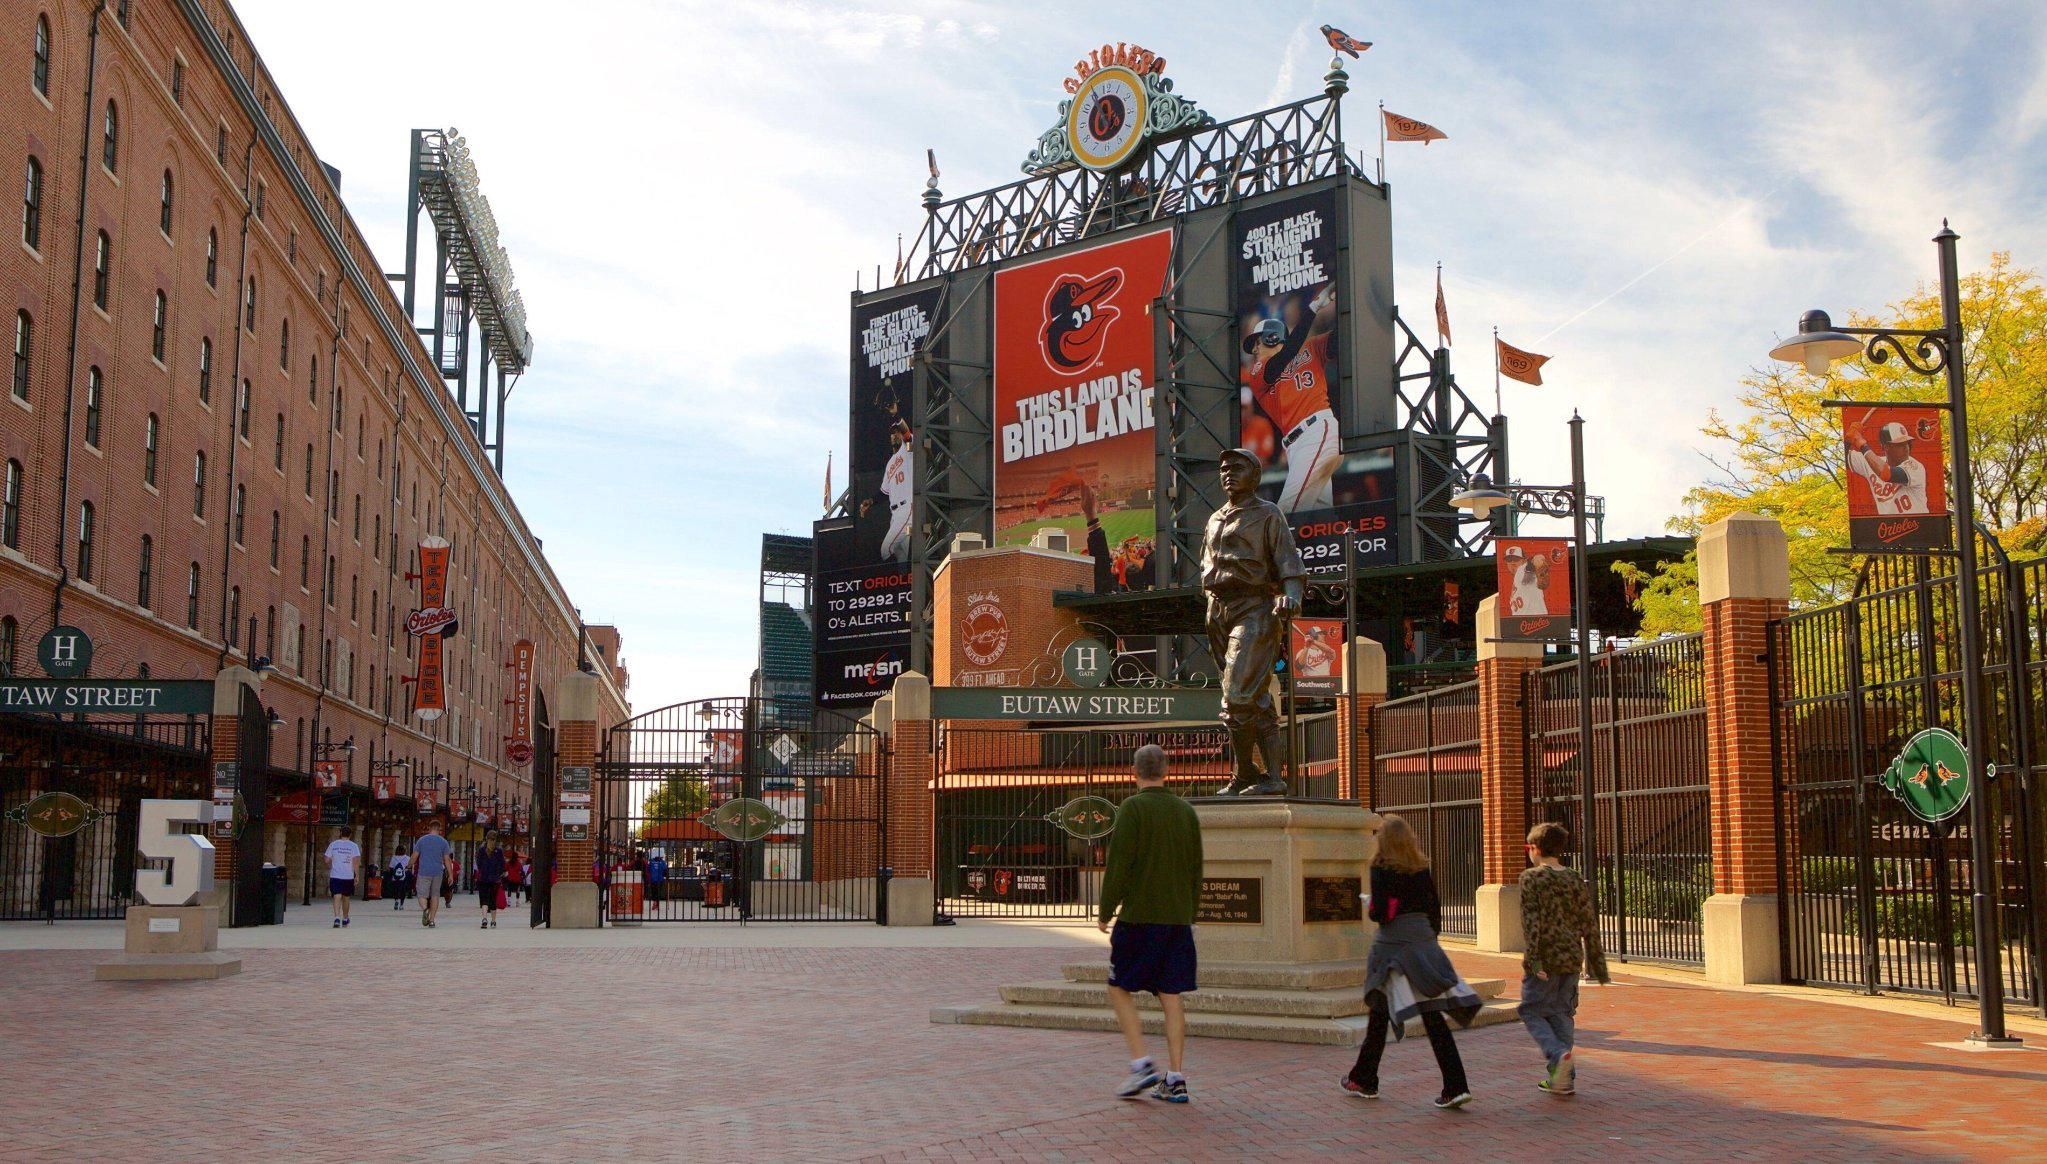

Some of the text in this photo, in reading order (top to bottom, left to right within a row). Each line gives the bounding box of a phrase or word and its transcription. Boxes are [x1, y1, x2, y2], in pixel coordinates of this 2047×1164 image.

[1398, 121, 1427, 132] 1979
[1242, 218, 1323, 260] STRAIGHT
[1246, 225, 1266, 241] 400
[1259, 242, 1302, 266] TO YOUR
[1252, 249, 1315, 284] MOBILE
[1268, 263, 1329, 296] PHONE.
[870, 304, 918, 330] FIRST IT HITS
[862, 325, 887, 345] THE
[862, 321, 930, 355] THEN IT HITS YOUR
[868, 338, 915, 368] MOBILE
[880, 356, 914, 379] PHON
[1294, 370, 1314, 391] 13
[1016, 367, 1142, 423] THIS LAND IS
[895, 470, 905, 485] 10
[1894, 494, 1913, 514] 10
[1877, 518, 1920, 544] Orioles
[1296, 537, 1387, 563] 292 OR
[426, 552, 442, 603] TEAM
[828, 572, 912, 594] TEXT ORIOLE
[828, 590, 912, 611] TO 29292 FO
[408, 607, 457, 633] Orioles
[828, 611, 902, 629] O's ALERTS.
[969, 606, 1002, 620] BREW PUB
[1519, 617, 1552, 637] Orioles
[52, 635, 78, 661] H
[965, 645, 986, 664] EUTAW
[1074, 647, 1098, 671] H
[422, 638, 438, 704] STORE
[844, 658, 903, 681] masn
[985, 672, 1005, 686] AHEAD
[0, 686, 162, 707] TAW STREET
[518, 649, 527, 736] DEMPSEYS
[830, 689, 894, 700] FACEBOOK.COM/MA
[1001, 695, 1175, 715] EUTAW STREET
[136, 799, 215, 905] 5
[1210, 882, 1240, 891] DREAM
